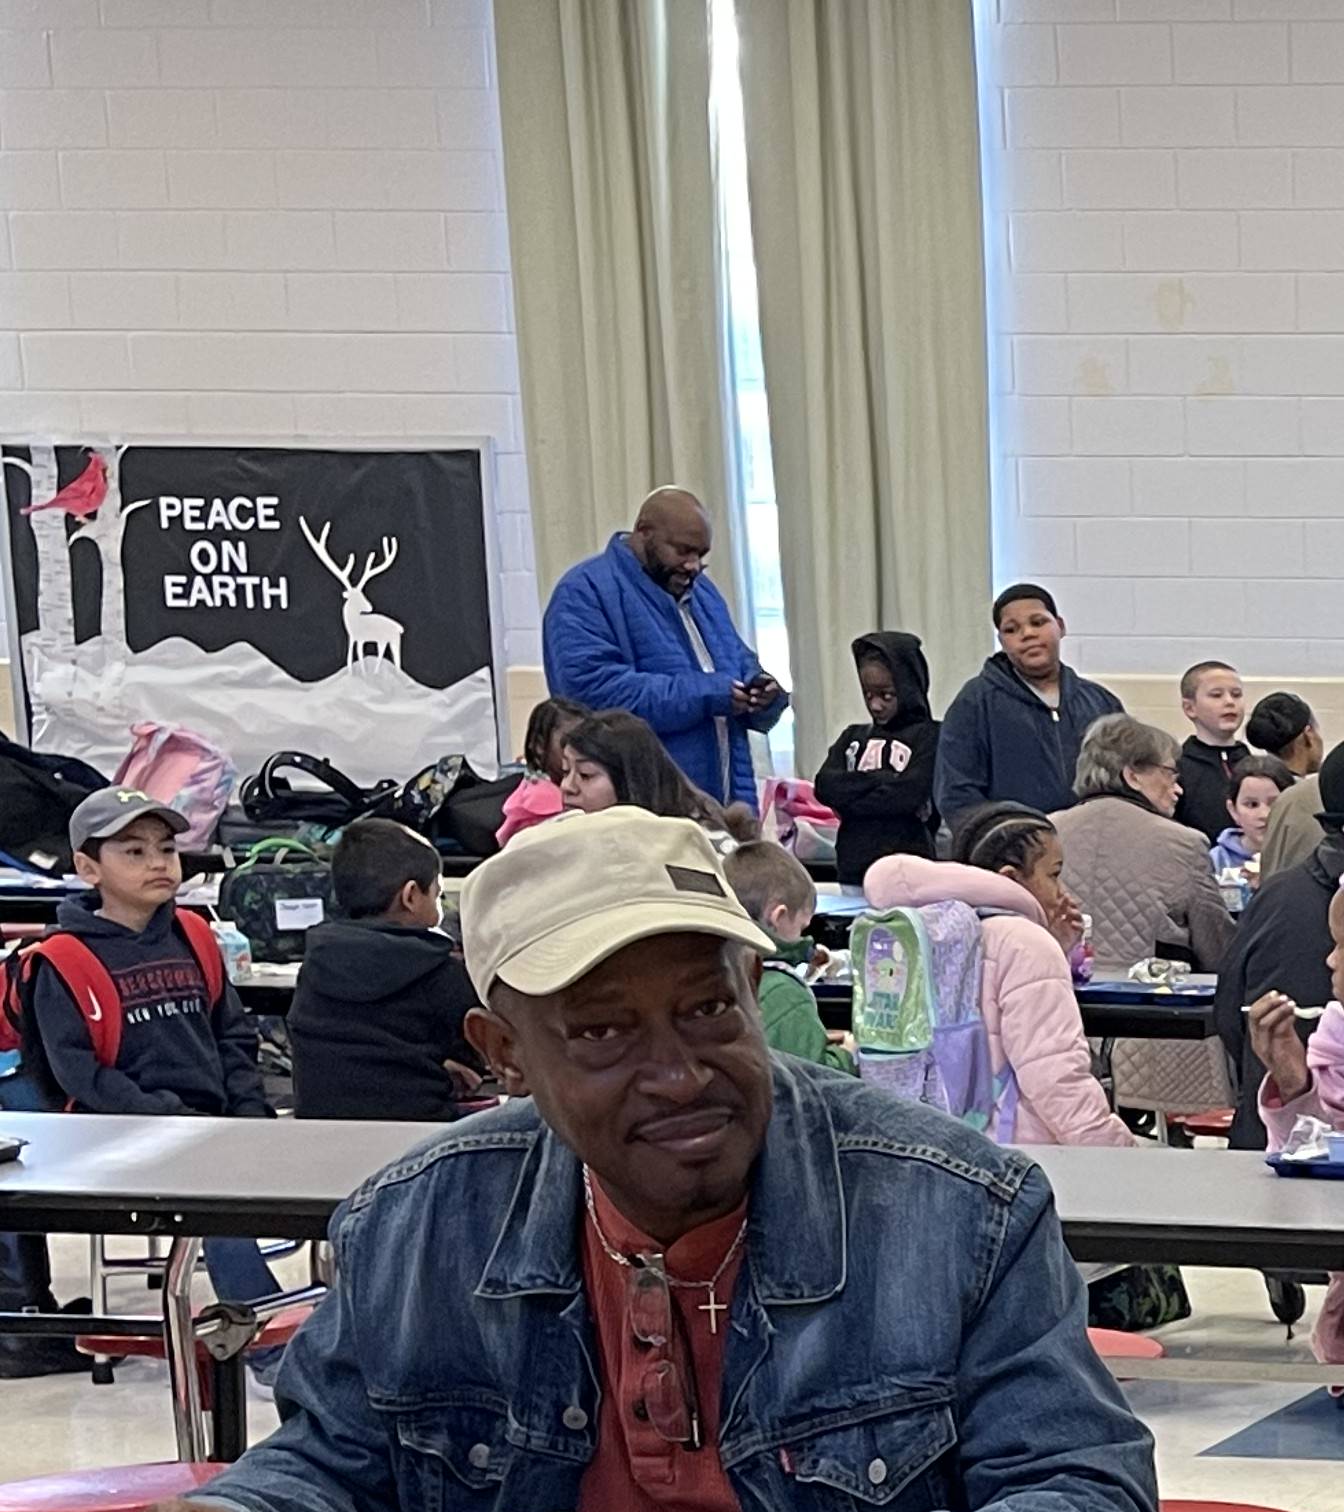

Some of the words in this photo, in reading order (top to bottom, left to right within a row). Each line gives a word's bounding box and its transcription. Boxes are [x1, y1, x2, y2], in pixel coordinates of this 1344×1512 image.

[159, 496, 281, 531] PEACE
[190, 540, 248, 574] ON
[164, 575, 288, 609] EARTH
